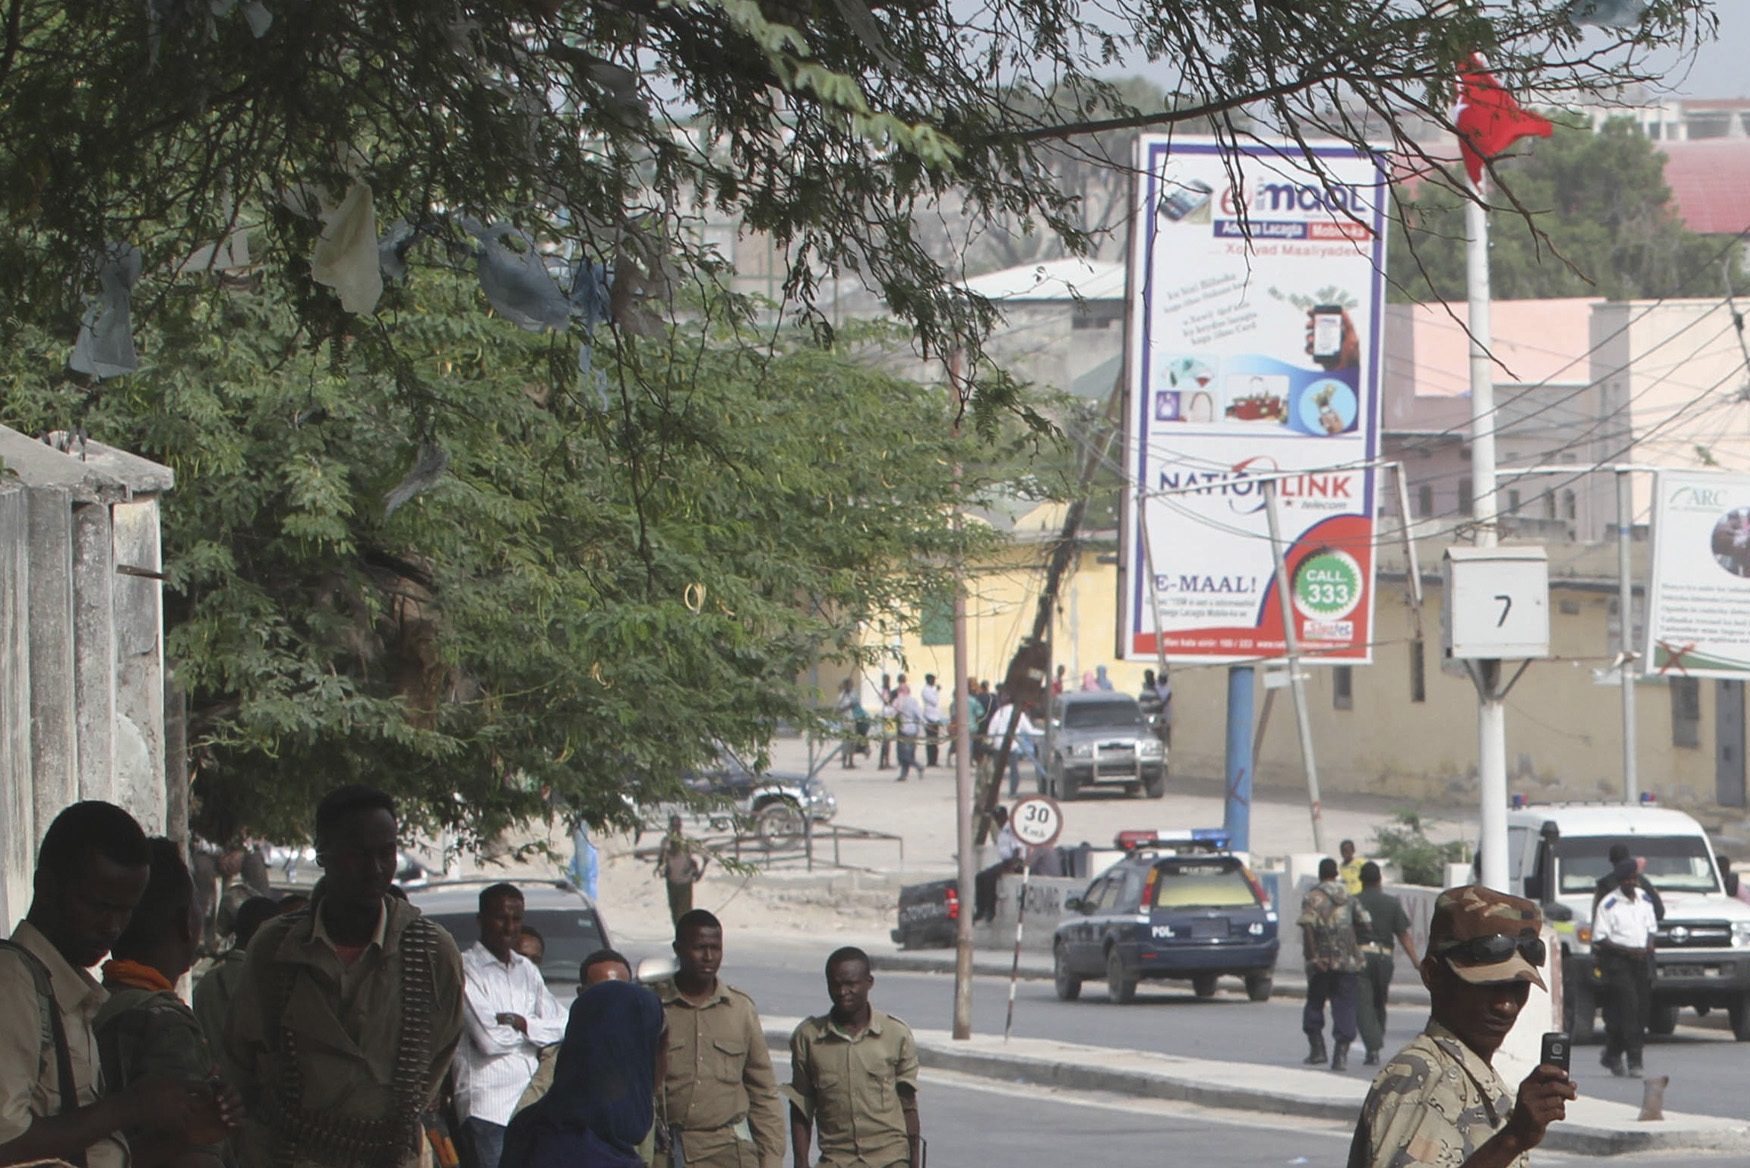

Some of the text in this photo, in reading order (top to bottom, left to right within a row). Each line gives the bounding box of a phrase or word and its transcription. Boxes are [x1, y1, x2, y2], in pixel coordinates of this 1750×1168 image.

[1688, 487, 1729, 507] ARC
[1154, 574, 1257, 593] E-MAAL!
[1308, 585, 1349, 603] 333
[1494, 595, 1511, 628] 7
[1025, 804, 1049, 823] 30
[1248, 923, 1263, 935] 48
